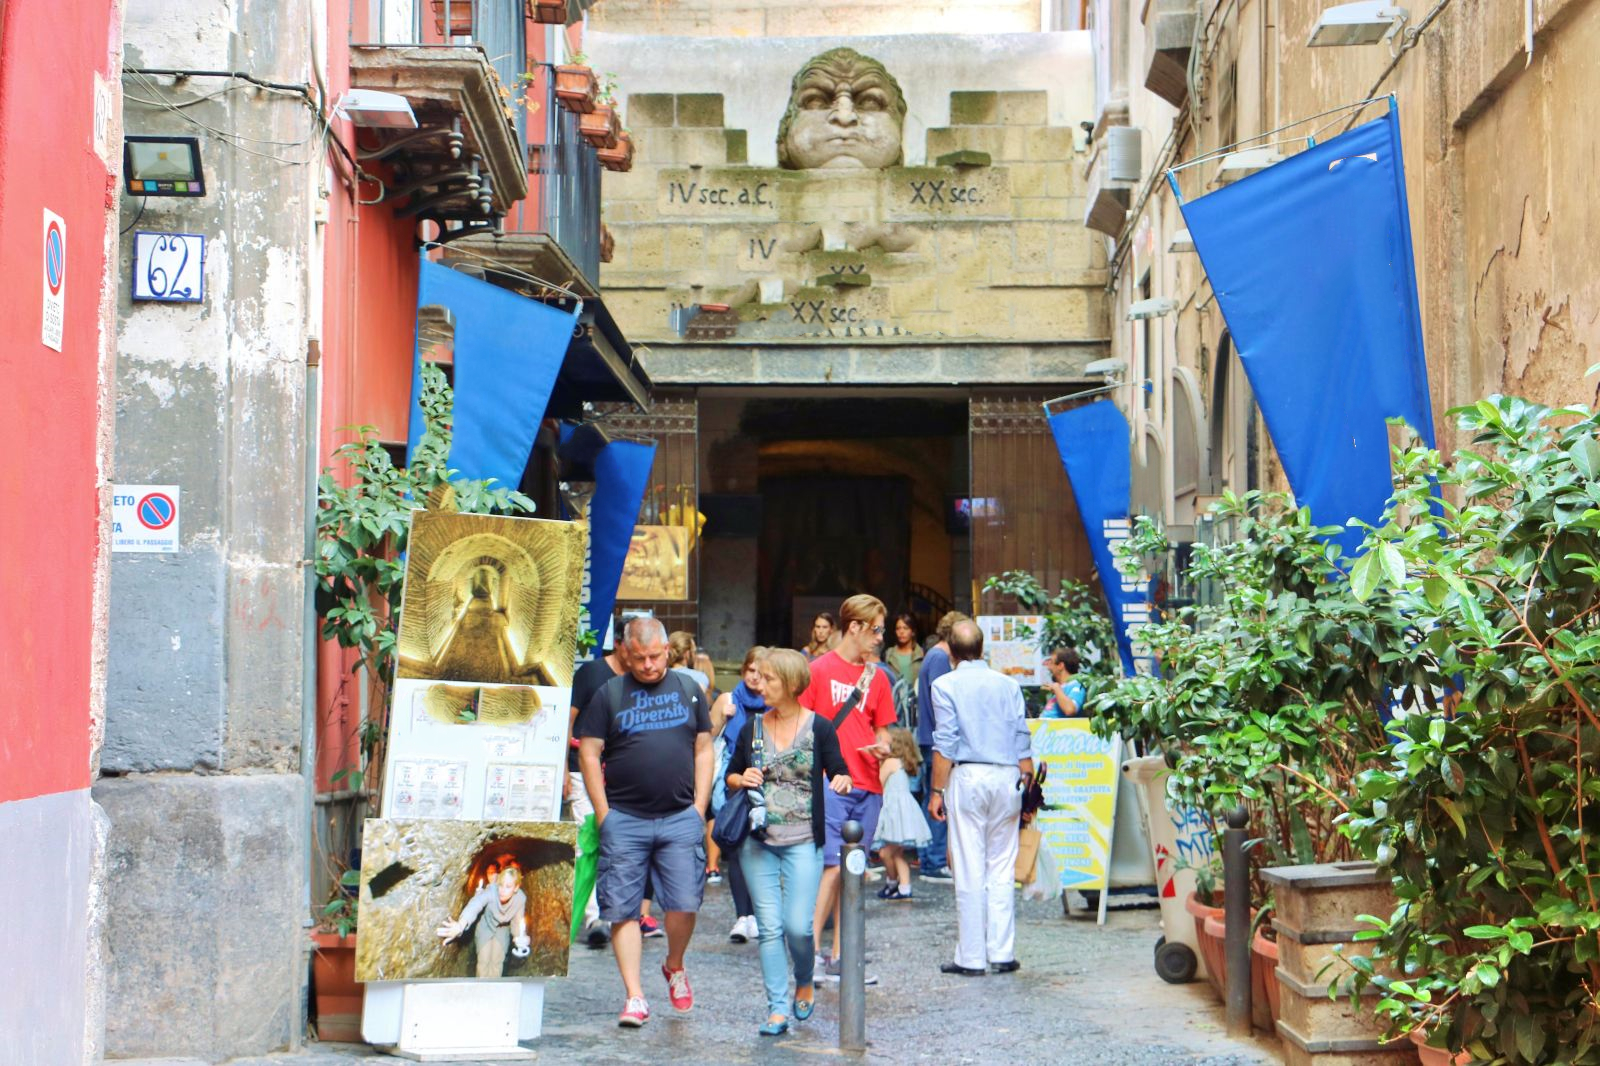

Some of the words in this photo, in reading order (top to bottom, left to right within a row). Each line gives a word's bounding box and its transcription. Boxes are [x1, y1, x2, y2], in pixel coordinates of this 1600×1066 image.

[910, 181, 945, 204] XX
[948, 185, 985, 204] sec.
[749, 238, 777, 259] IV
[147, 234, 192, 297] 62
[790, 300, 825, 324] XX
[830, 306, 863, 323] sec.
[631, 689, 679, 710] Brave
[616, 702, 689, 732] Diversity
